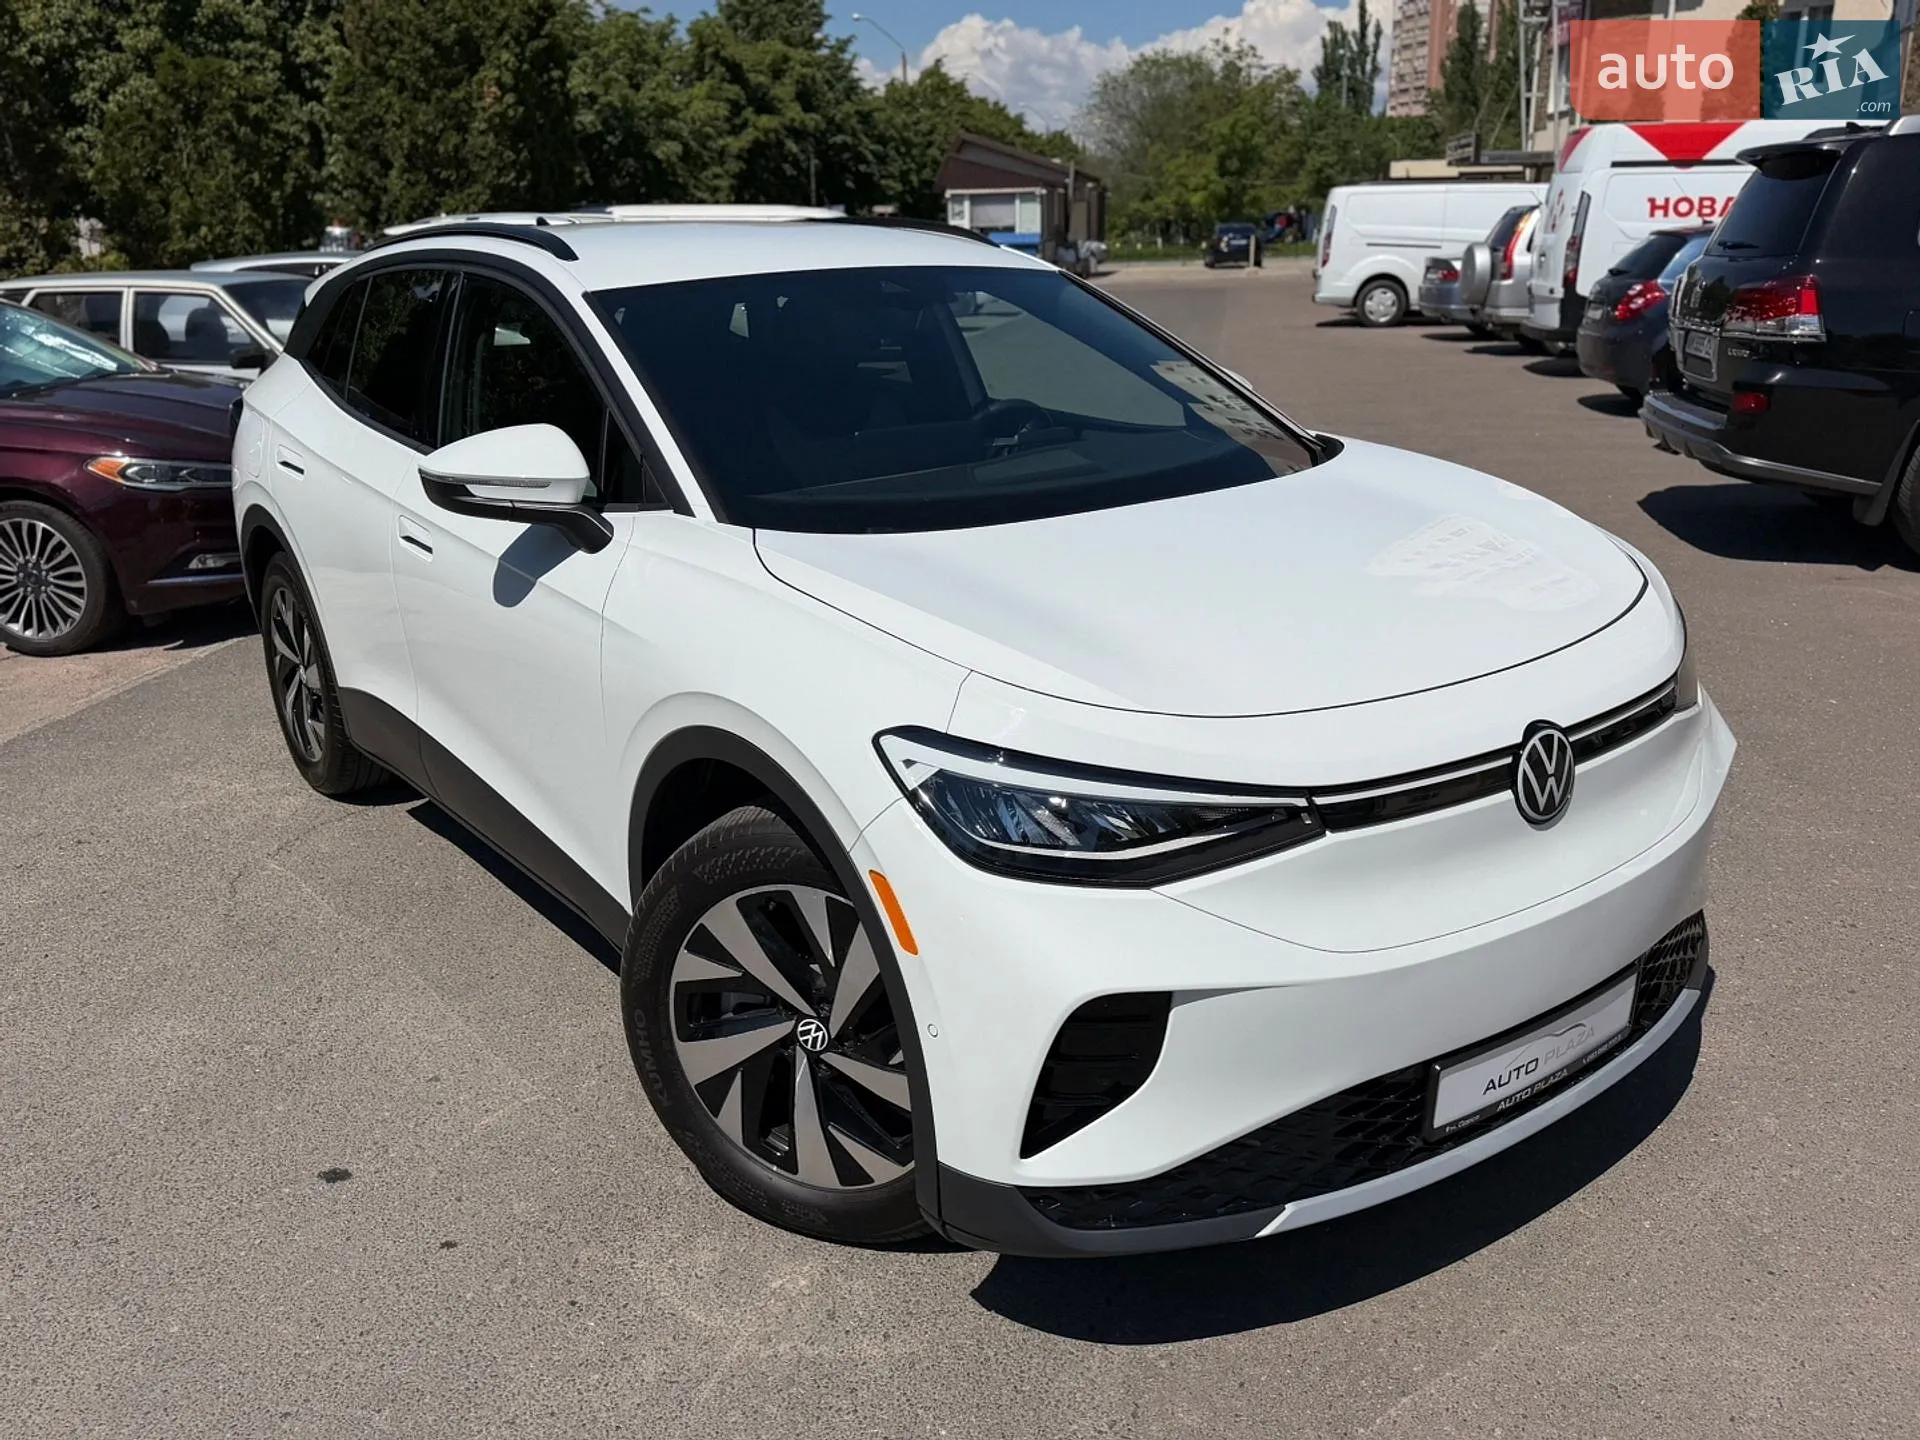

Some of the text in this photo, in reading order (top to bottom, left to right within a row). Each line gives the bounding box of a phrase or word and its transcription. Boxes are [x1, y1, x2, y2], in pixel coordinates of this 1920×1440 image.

[1483, 1058, 1539, 1096] AUTO
[1543, 1027, 1596, 1066] PLAZA
[1496, 1088, 1532, 1112] AUTO
